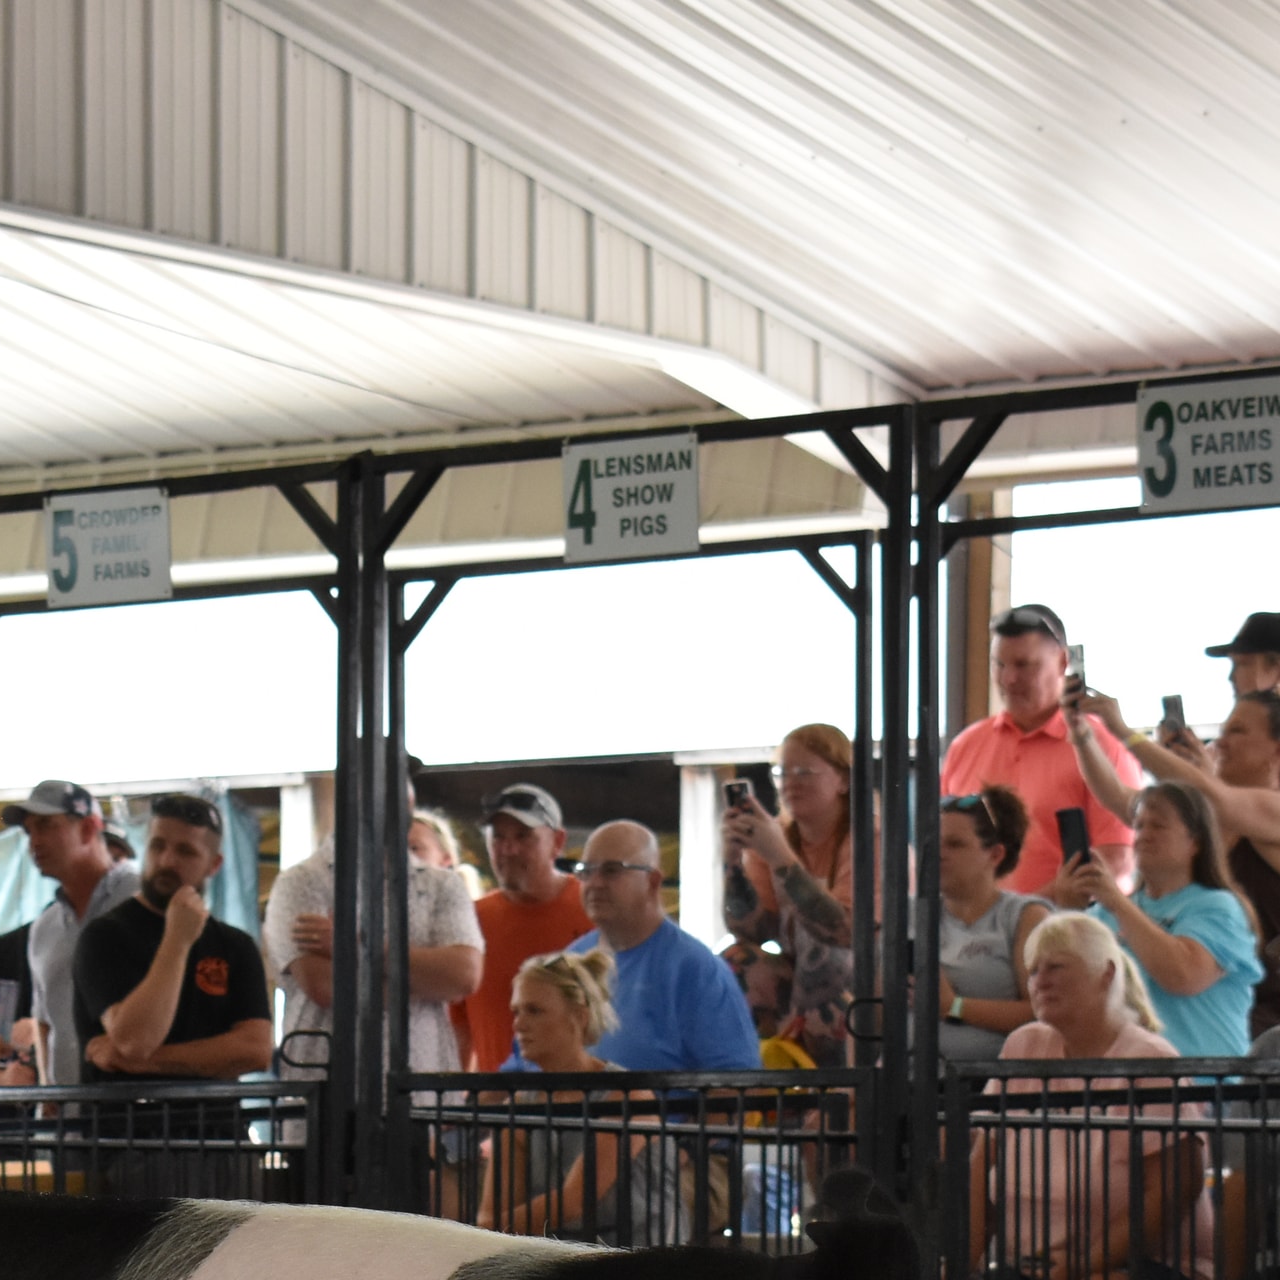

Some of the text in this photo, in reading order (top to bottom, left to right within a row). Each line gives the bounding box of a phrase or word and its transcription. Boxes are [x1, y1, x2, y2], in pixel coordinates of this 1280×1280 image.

[1144, 401, 1177, 498] 3
[1191, 429, 1272, 456] FARMS
[593, 450, 692, 479] LENSMAN
[1193, 462, 1273, 489] MEATS
[568, 459, 596, 545] 4
[612, 483, 674, 508] SHOW
[78, 505, 161, 530] CROWDER
[620, 514, 668, 538] PIGS
[52, 509, 78, 594] 5
[91, 532, 149, 556] FAMIL
[93, 560, 151, 582] FARMS
